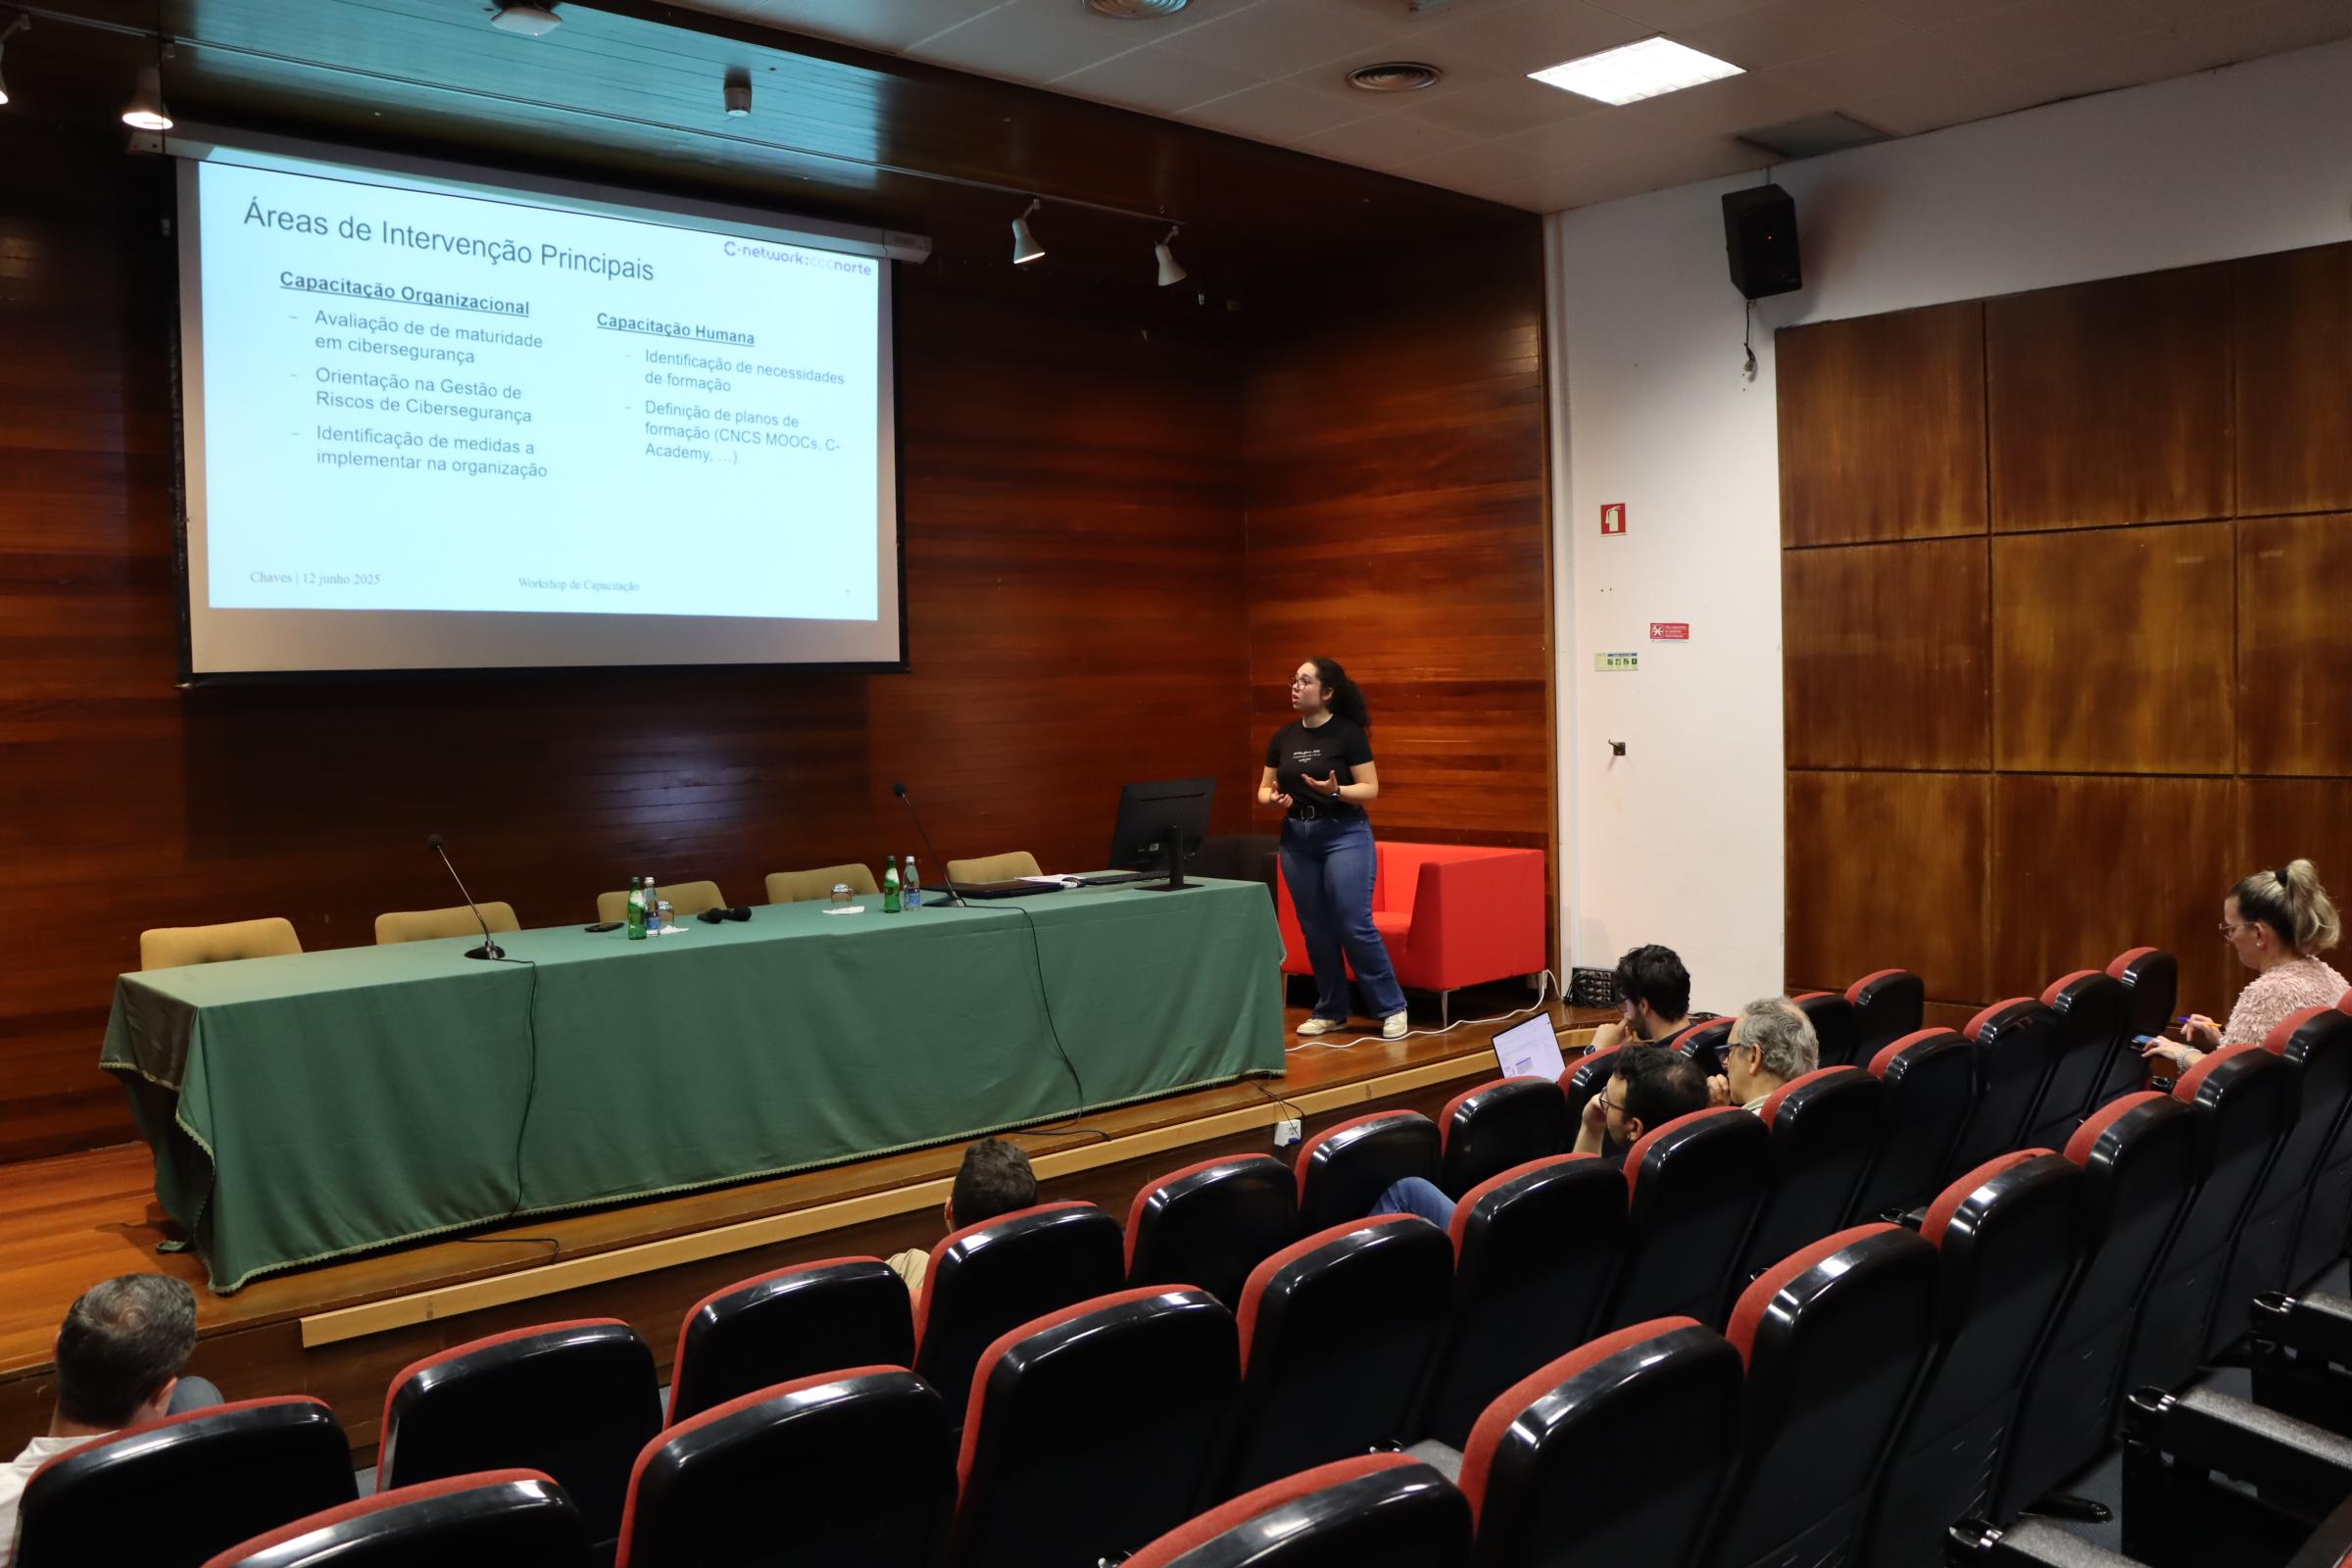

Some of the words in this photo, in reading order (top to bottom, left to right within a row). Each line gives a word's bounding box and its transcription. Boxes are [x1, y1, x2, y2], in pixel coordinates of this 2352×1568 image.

[244, 196, 329, 236] Áreas
[338, 216, 372, 242] de
[382, 220, 532, 266] Intervenção
[541, 244, 655, 280] Principais
[279, 271, 396, 299] Capacitação
[401, 286, 530, 316] Organizacional
[315, 310, 399, 334] Avaliação
[404, 319, 424, 336] de
[429, 322, 451, 338] de
[455, 326, 543, 348] maturidade
[597, 313, 691, 338] Capacitação
[696, 324, 756, 346] Humana
[315, 337, 342, 351] em
[348, 337, 475, 367] cibersegurança
[645, 349, 732, 373] Identificação
[736, 360, 753, 374] de
[757, 363, 845, 385] necessidades
[316, 368, 410, 391] Orientação
[415, 377, 435, 392] na
[440, 378, 498, 399] Gestão
[503, 385, 522, 400] de
[645, 370, 662, 384] de
[667, 372, 731, 393] formação
[316, 390, 374, 410] Riscos
[379, 397, 401, 412] de
[406, 398, 532, 425] Cibersegurança
[645, 400, 710, 420] Definição
[714, 408, 731, 421] de
[735, 410, 779, 427] planos
[782, 416, 800, 428] de
[317, 424, 423, 449] Identificação
[428, 433, 449, 449] de
[454, 435, 520, 455] medidas
[525, 444, 535, 455] a
[645, 421, 710, 441] formação
[714, 427, 761, 445] (CNCS
[317, 449, 421, 469] implementar
[426, 458, 447, 471] na
[452, 460, 548, 480] organização
[250, 571, 293, 584] Chaves
[303, 572, 316, 584] 12
[318, 573, 351, 586] junho
[354, 573, 381, 585] 2025
[517, 577, 567, 592] Workshop
[569, 579, 581, 590] de
